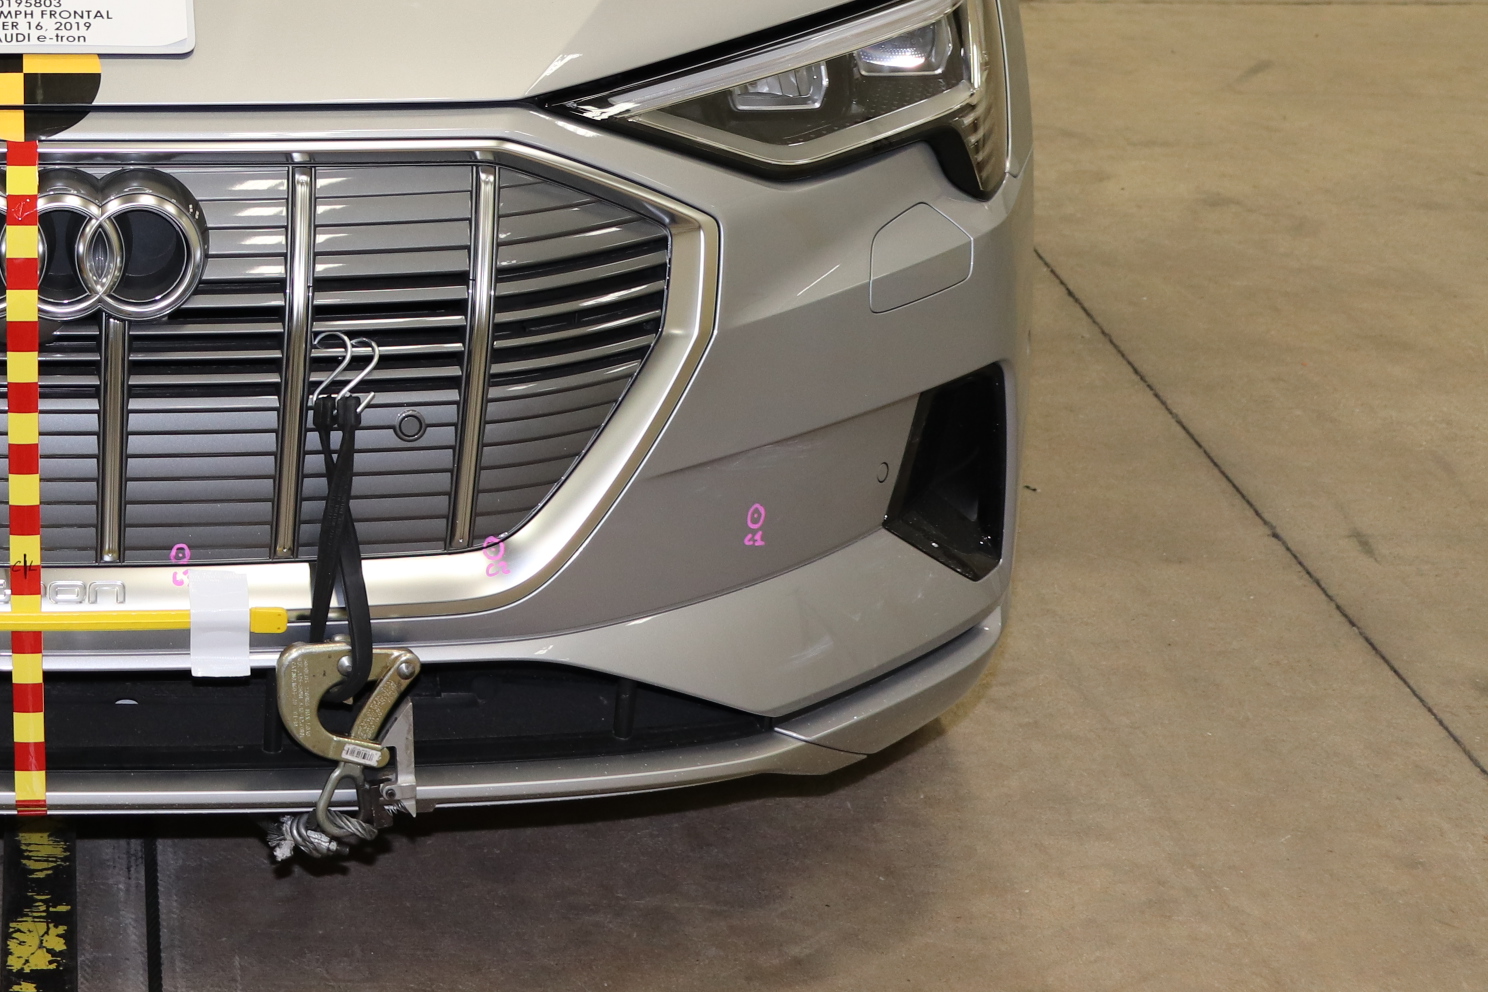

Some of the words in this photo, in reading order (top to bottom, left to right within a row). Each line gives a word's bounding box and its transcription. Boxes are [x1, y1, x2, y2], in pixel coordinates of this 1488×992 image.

[41, 10, 113, 19] FRONTAL
[27, 21, 48, 32] 16,
[54, 21, 92, 31] 2019
[37, 33, 86, 43] e-tron
[485, 561, 511, 577] C2
